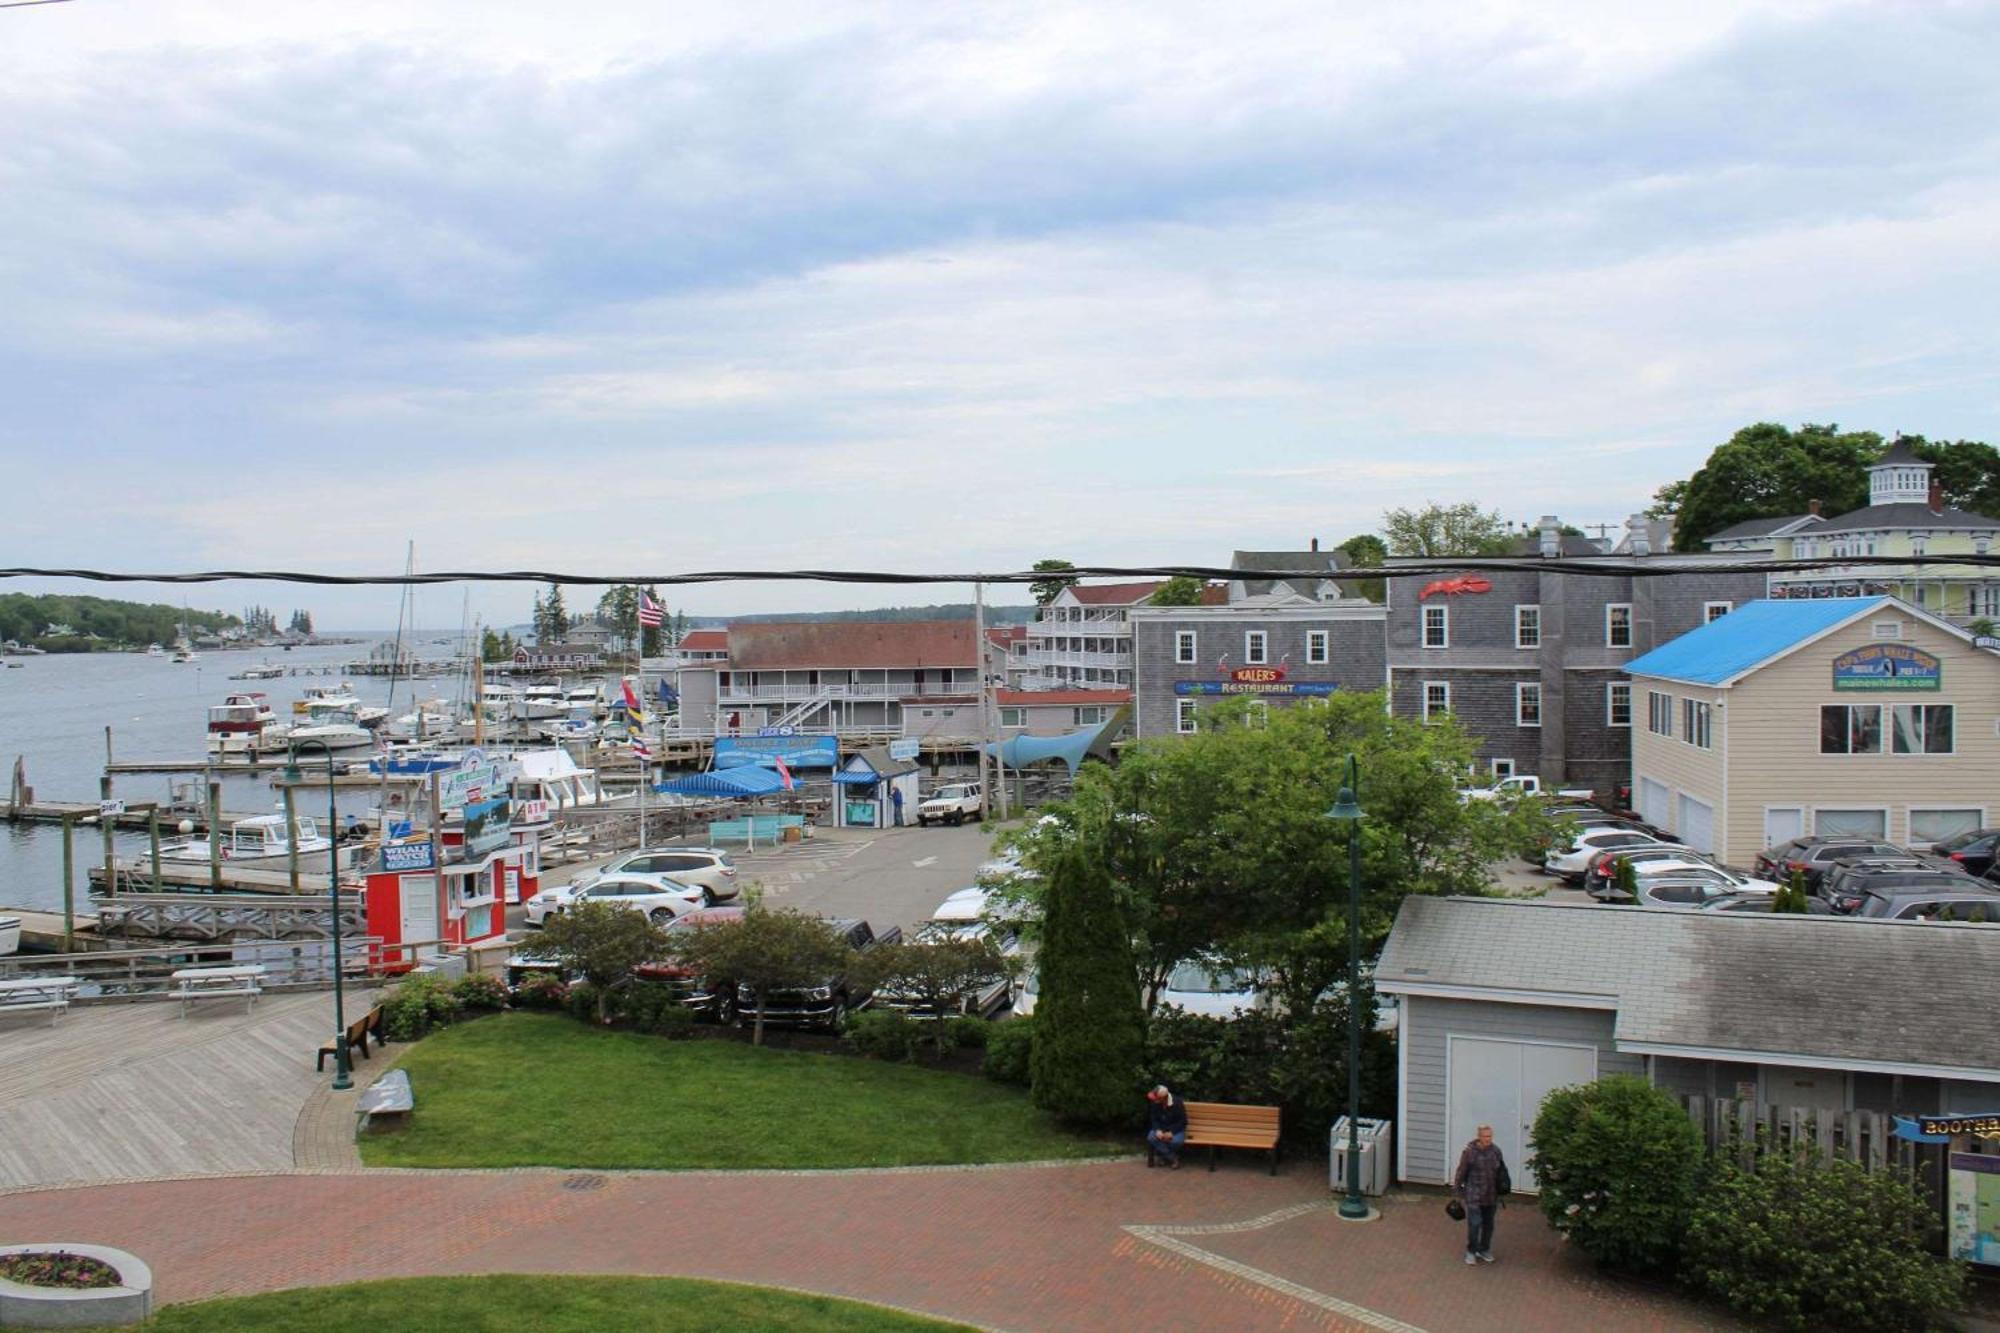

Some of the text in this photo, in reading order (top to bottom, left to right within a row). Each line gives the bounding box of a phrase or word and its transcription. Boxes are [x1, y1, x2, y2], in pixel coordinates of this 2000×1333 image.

[1221, 683, 1295, 693] RESTAURANT
[1838, 679, 1936, 687] mainewhales.com
[780, 726, 793, 736] 8
[528, 800, 546, 815] ATM
[384, 845, 431, 854] WHALE
[385, 852, 430, 862] WATCH
